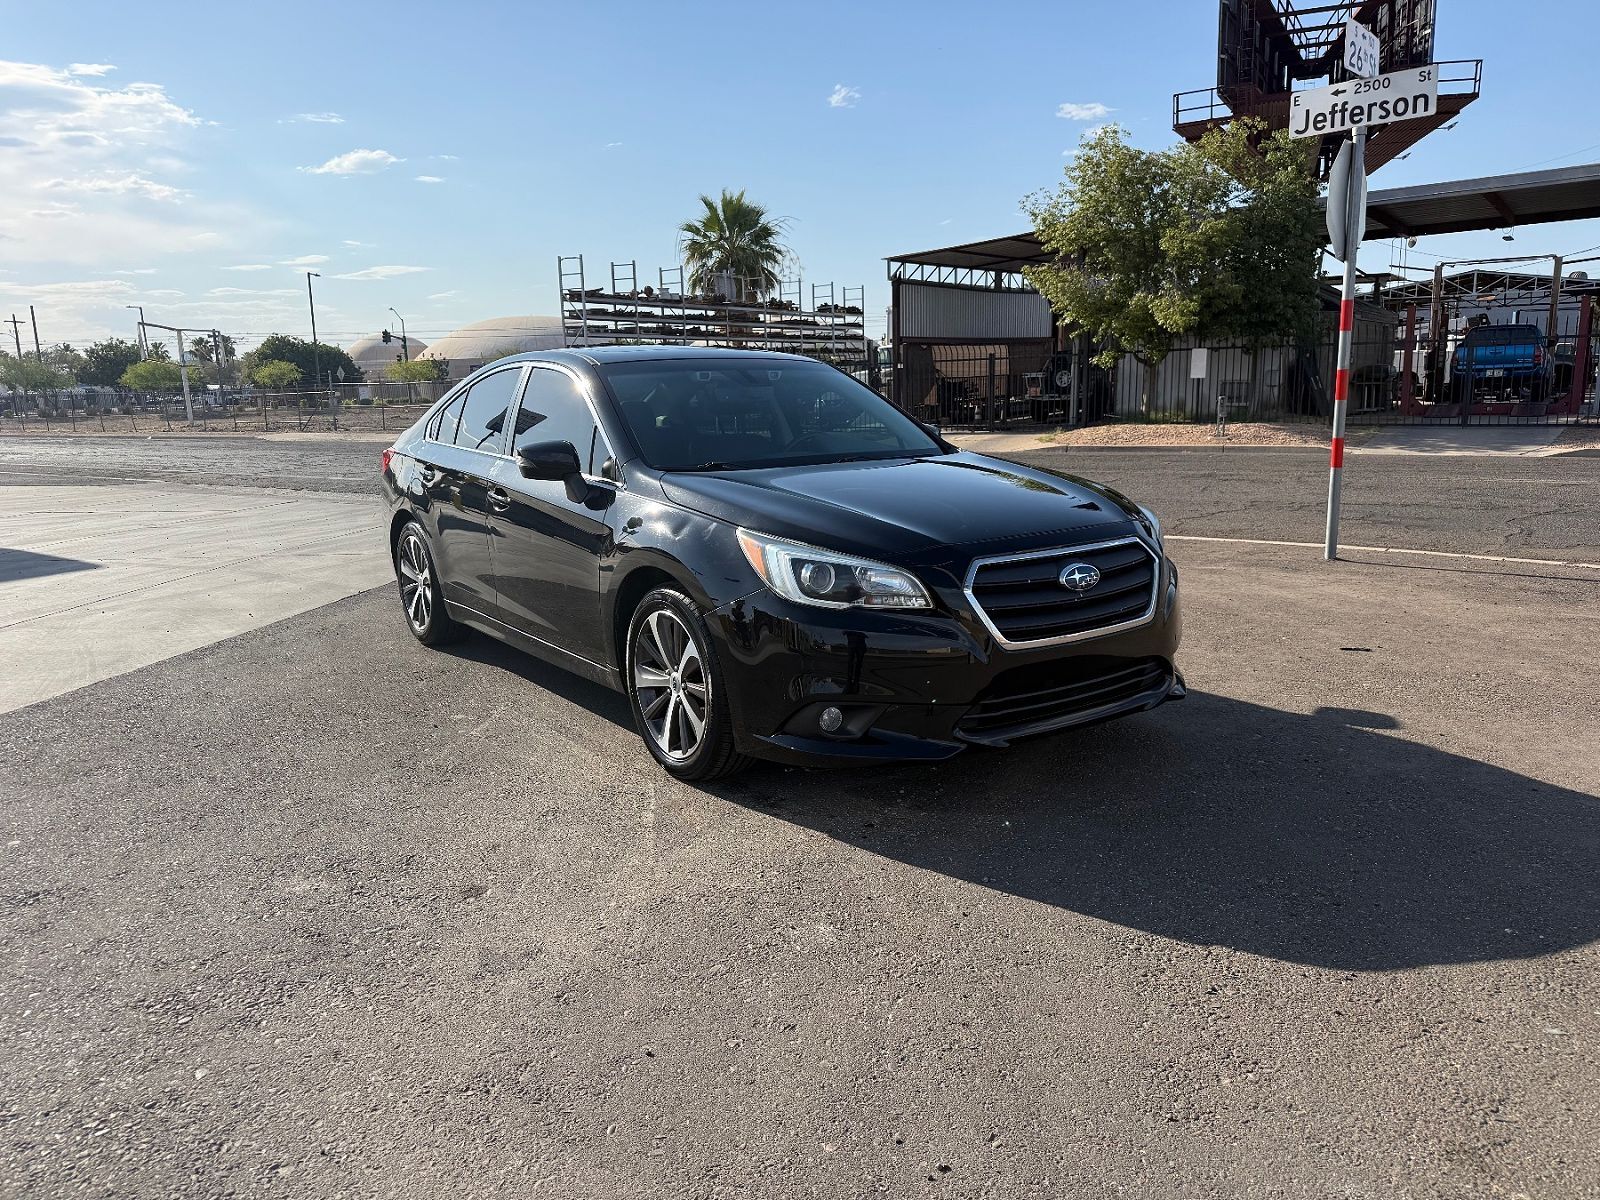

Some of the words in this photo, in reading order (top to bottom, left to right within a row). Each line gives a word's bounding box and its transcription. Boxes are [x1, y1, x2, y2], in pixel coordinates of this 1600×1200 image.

[1293, 96, 1301, 107] E
[1353, 77, 1391, 95] 2500
[1418, 70, 1432, 83] St
[1293, 93, 1429, 135] Jefferson
